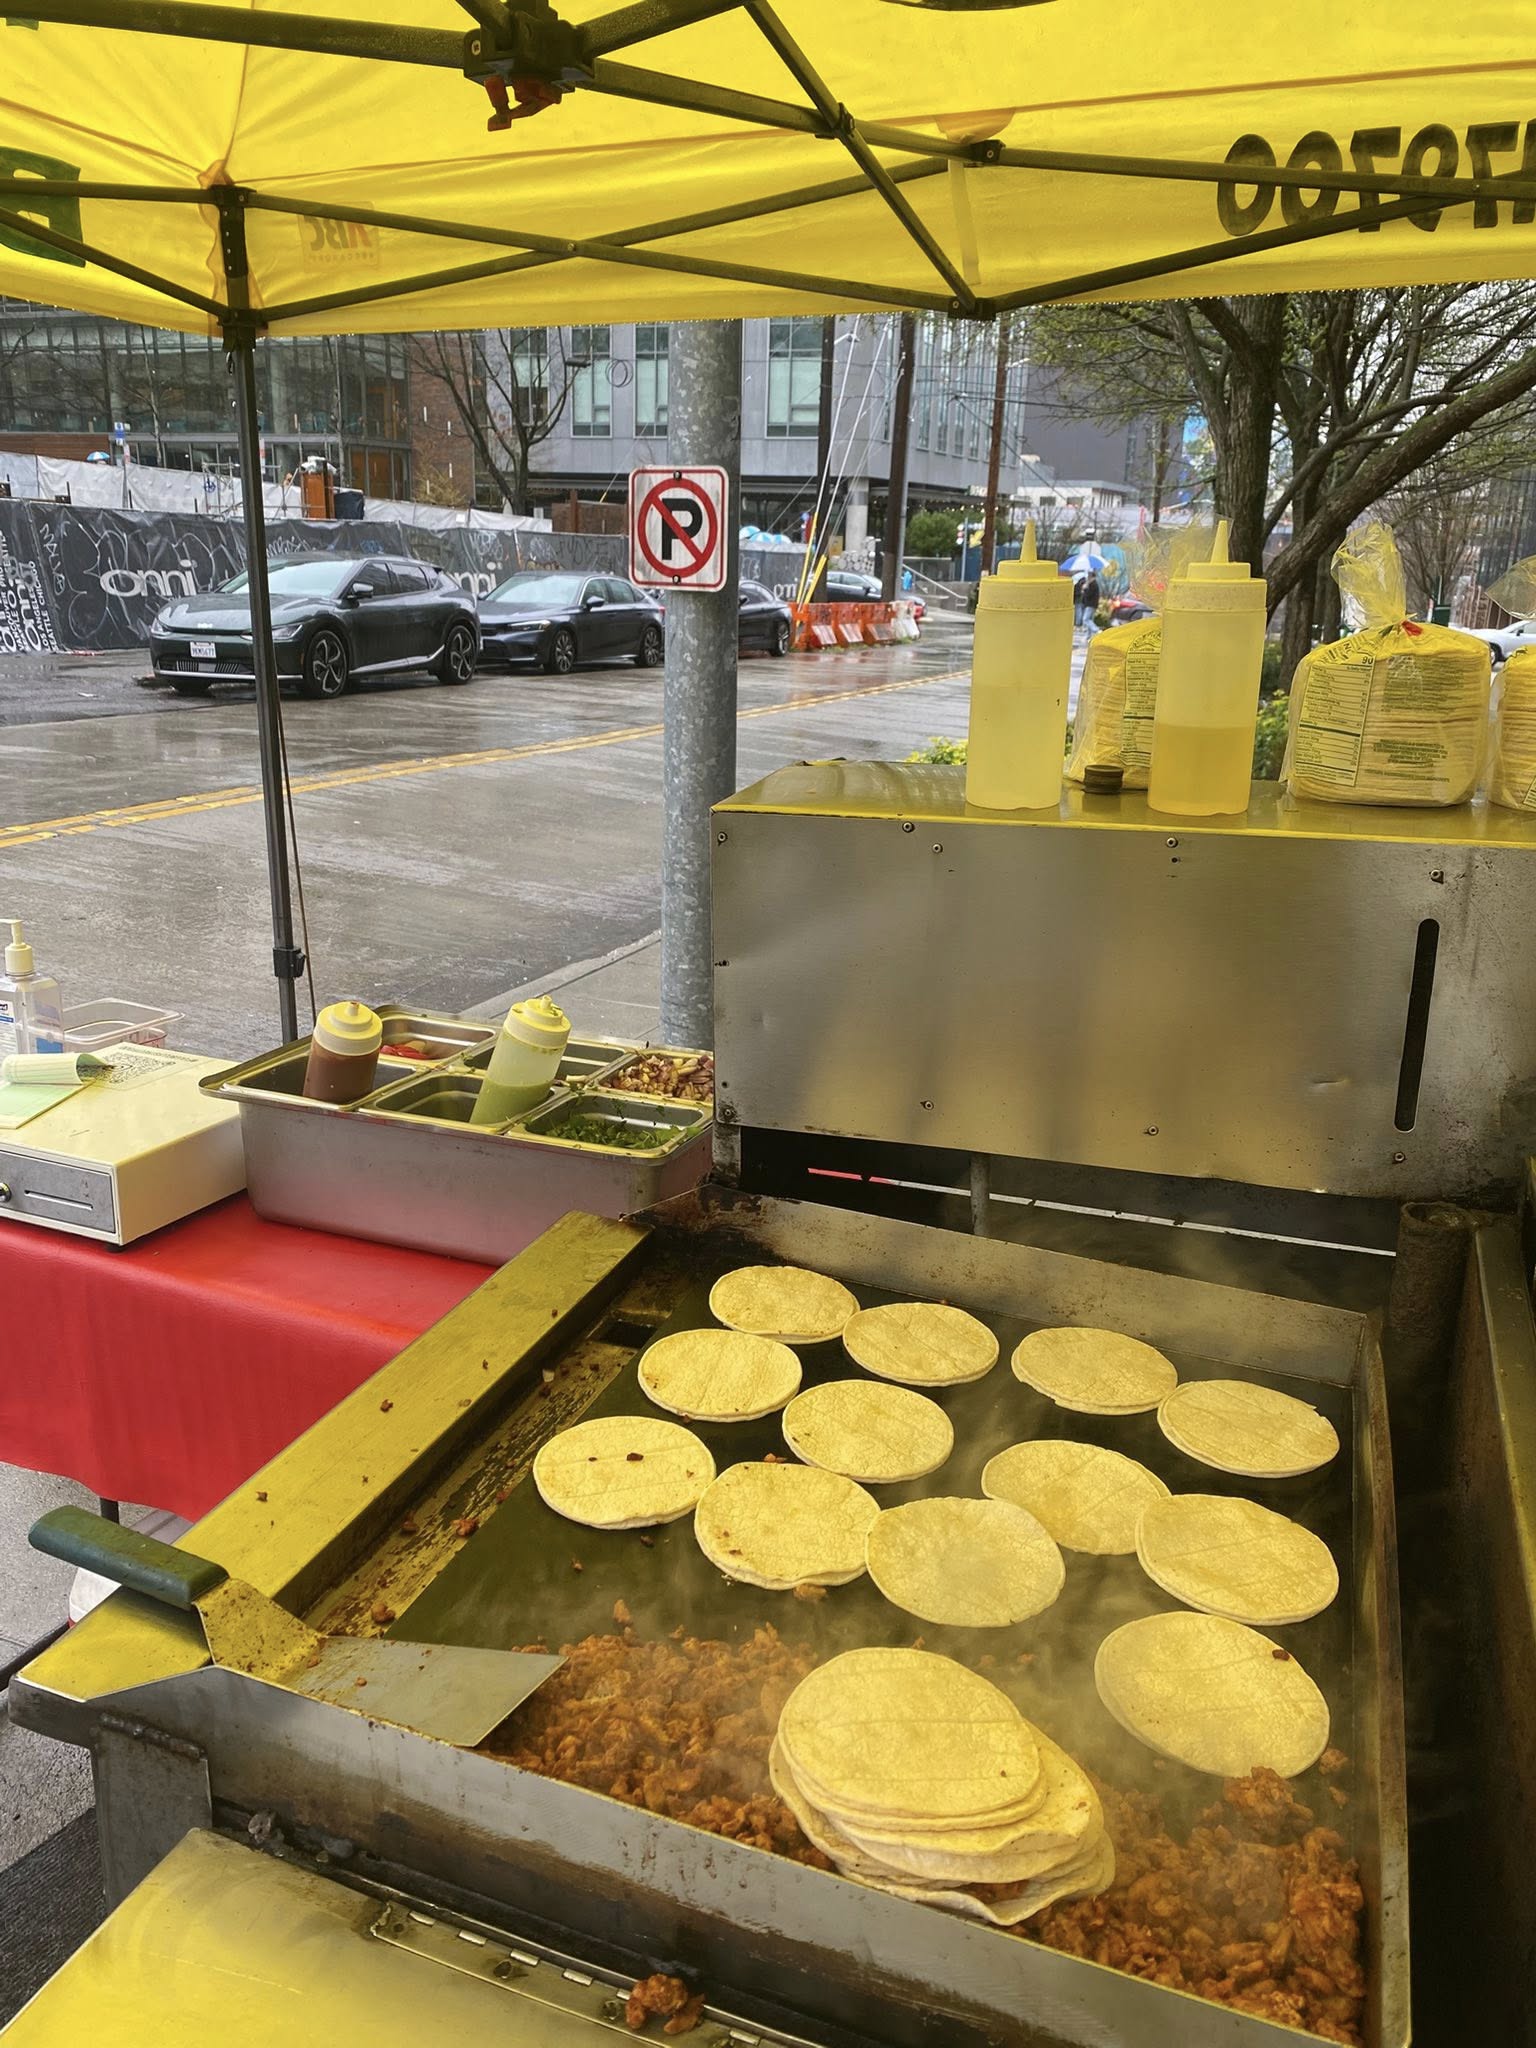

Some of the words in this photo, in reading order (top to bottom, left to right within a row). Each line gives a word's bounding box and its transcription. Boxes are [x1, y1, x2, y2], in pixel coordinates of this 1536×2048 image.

[662, 498, 703, 561] P
[100, 559, 197, 597] onni
[41, 610, 60, 652] SEATTLE
